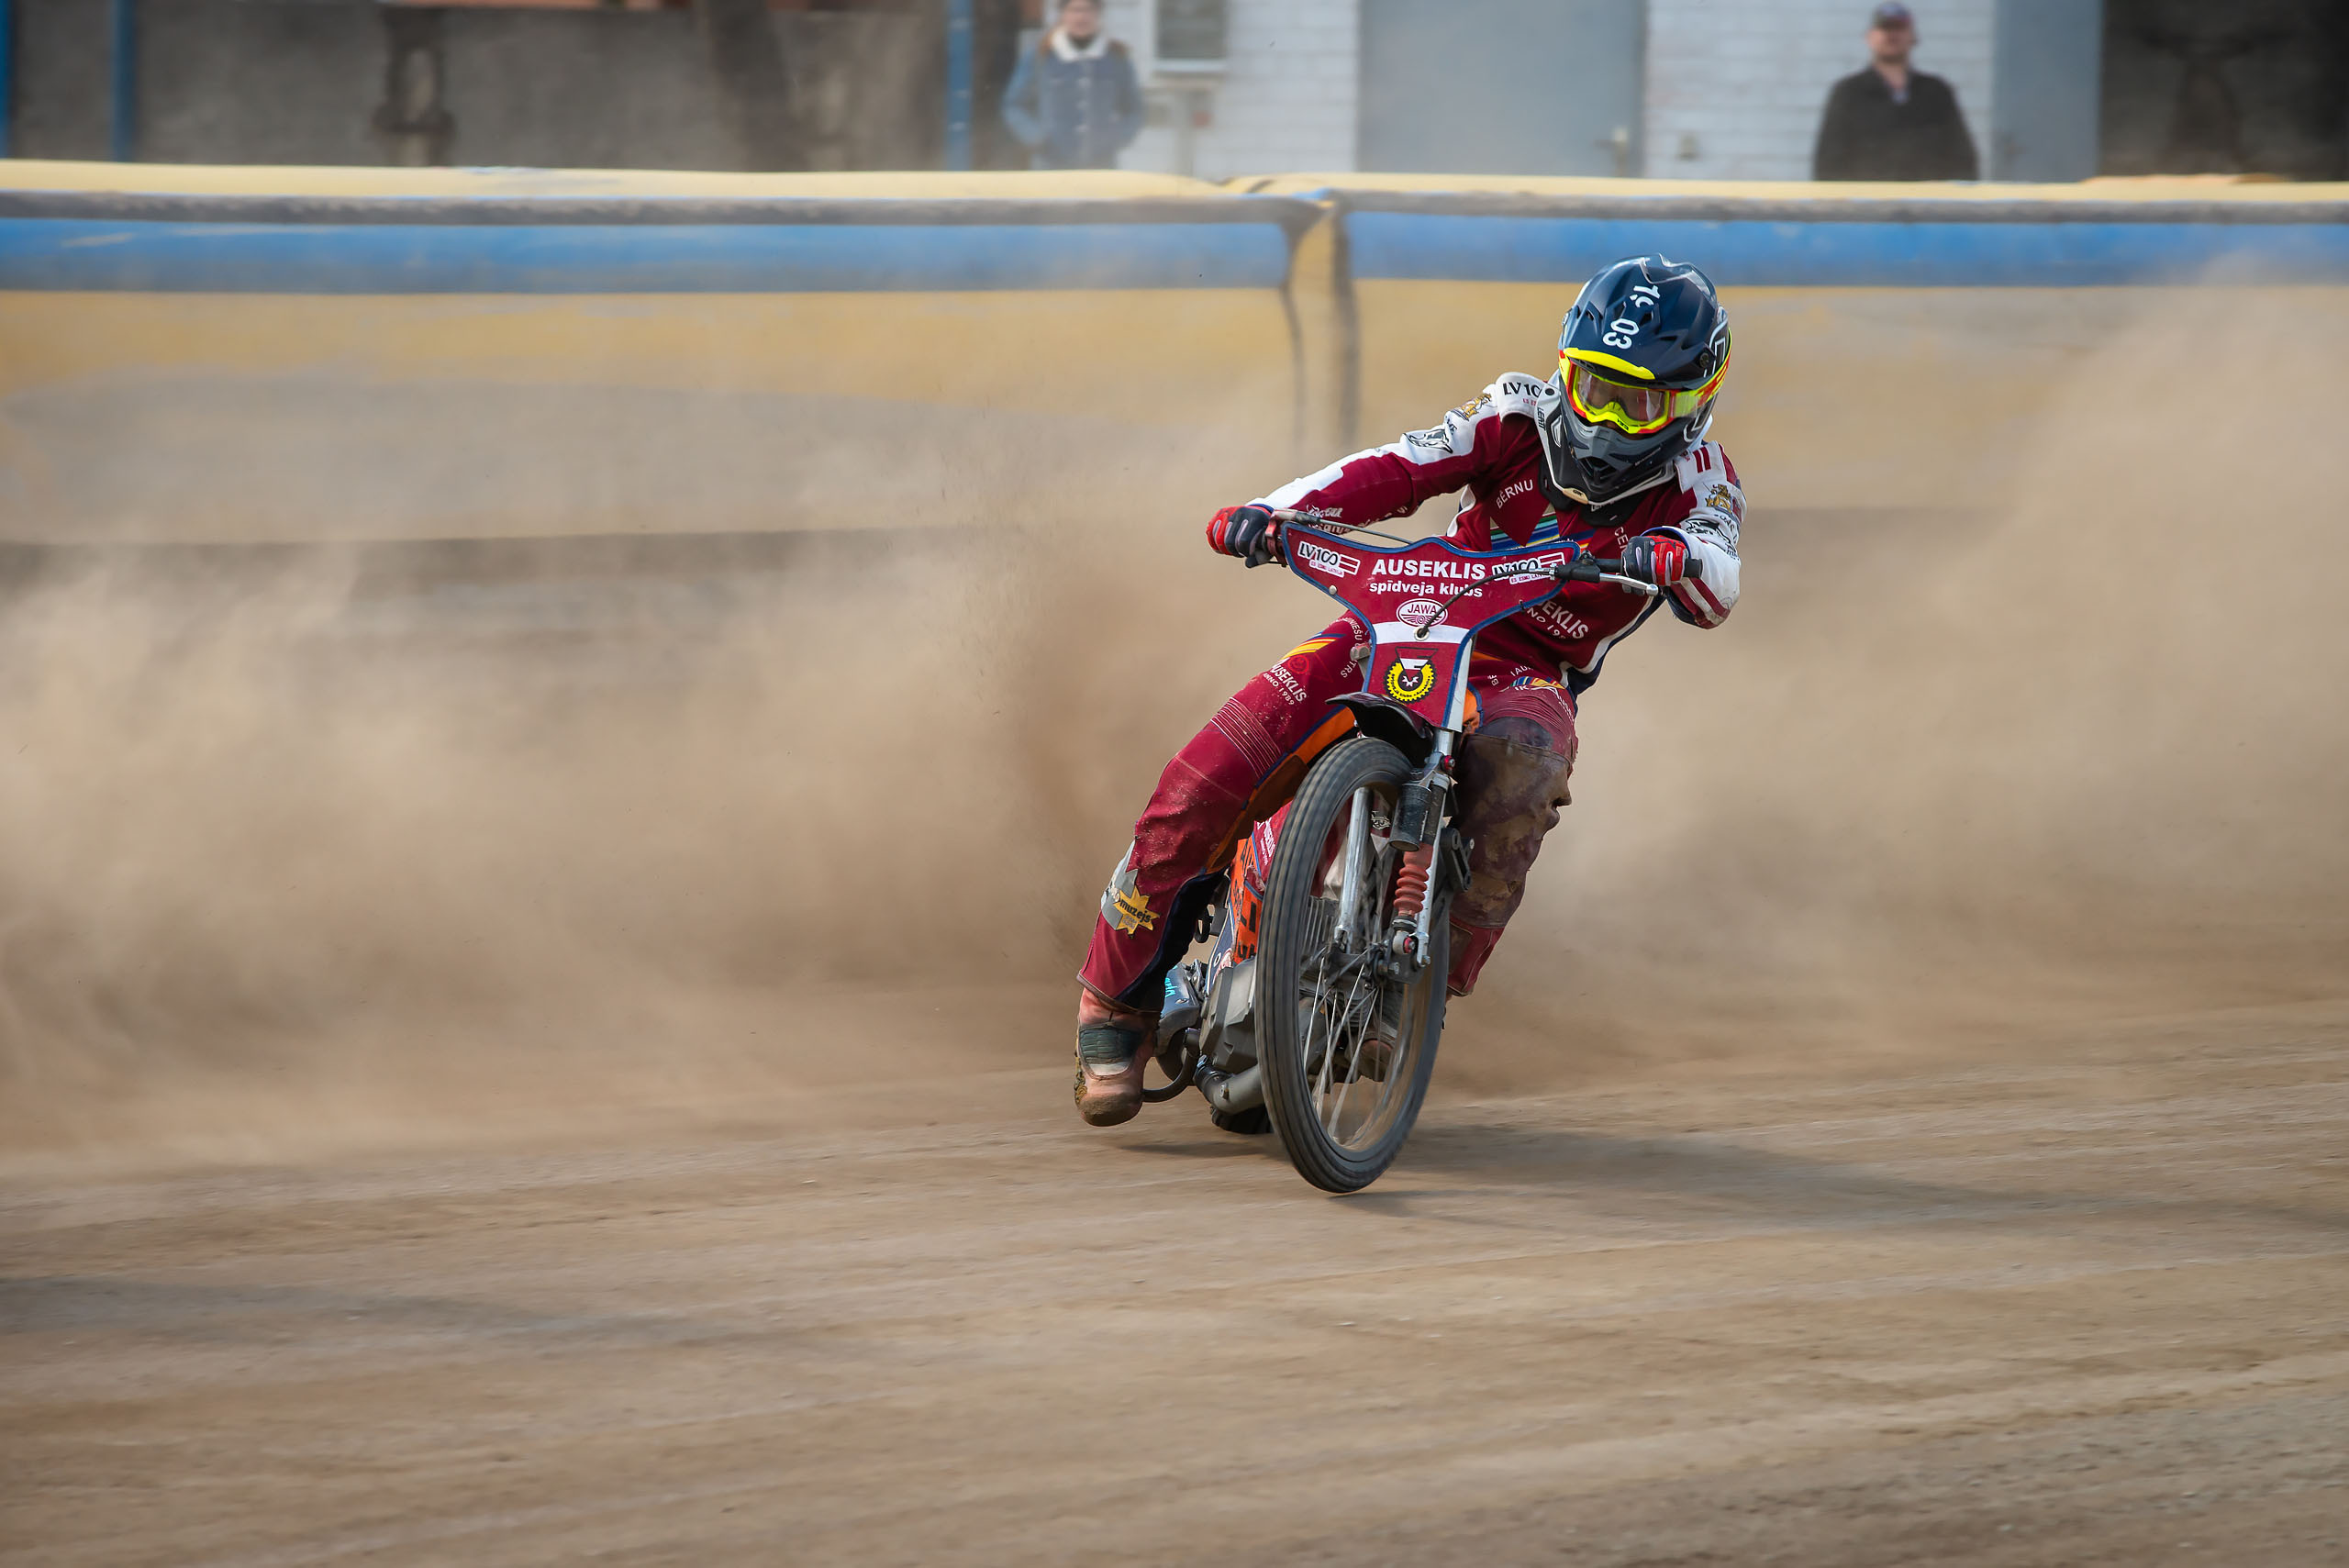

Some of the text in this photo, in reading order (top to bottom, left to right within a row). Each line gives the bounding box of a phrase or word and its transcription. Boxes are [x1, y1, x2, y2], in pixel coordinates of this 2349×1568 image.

[1602, 317, 1640, 350] 03
[1502, 382, 1542, 398] LV10
[1298, 542, 1339, 566] LV100
[1371, 559, 1486, 580] AUSEKLIS
[1369, 580, 1435, 596] spīdveja
[1407, 604, 1438, 615] JAWA
[1542, 599, 1589, 639] EKLIS
[1119, 899, 1152, 923] muzejs
